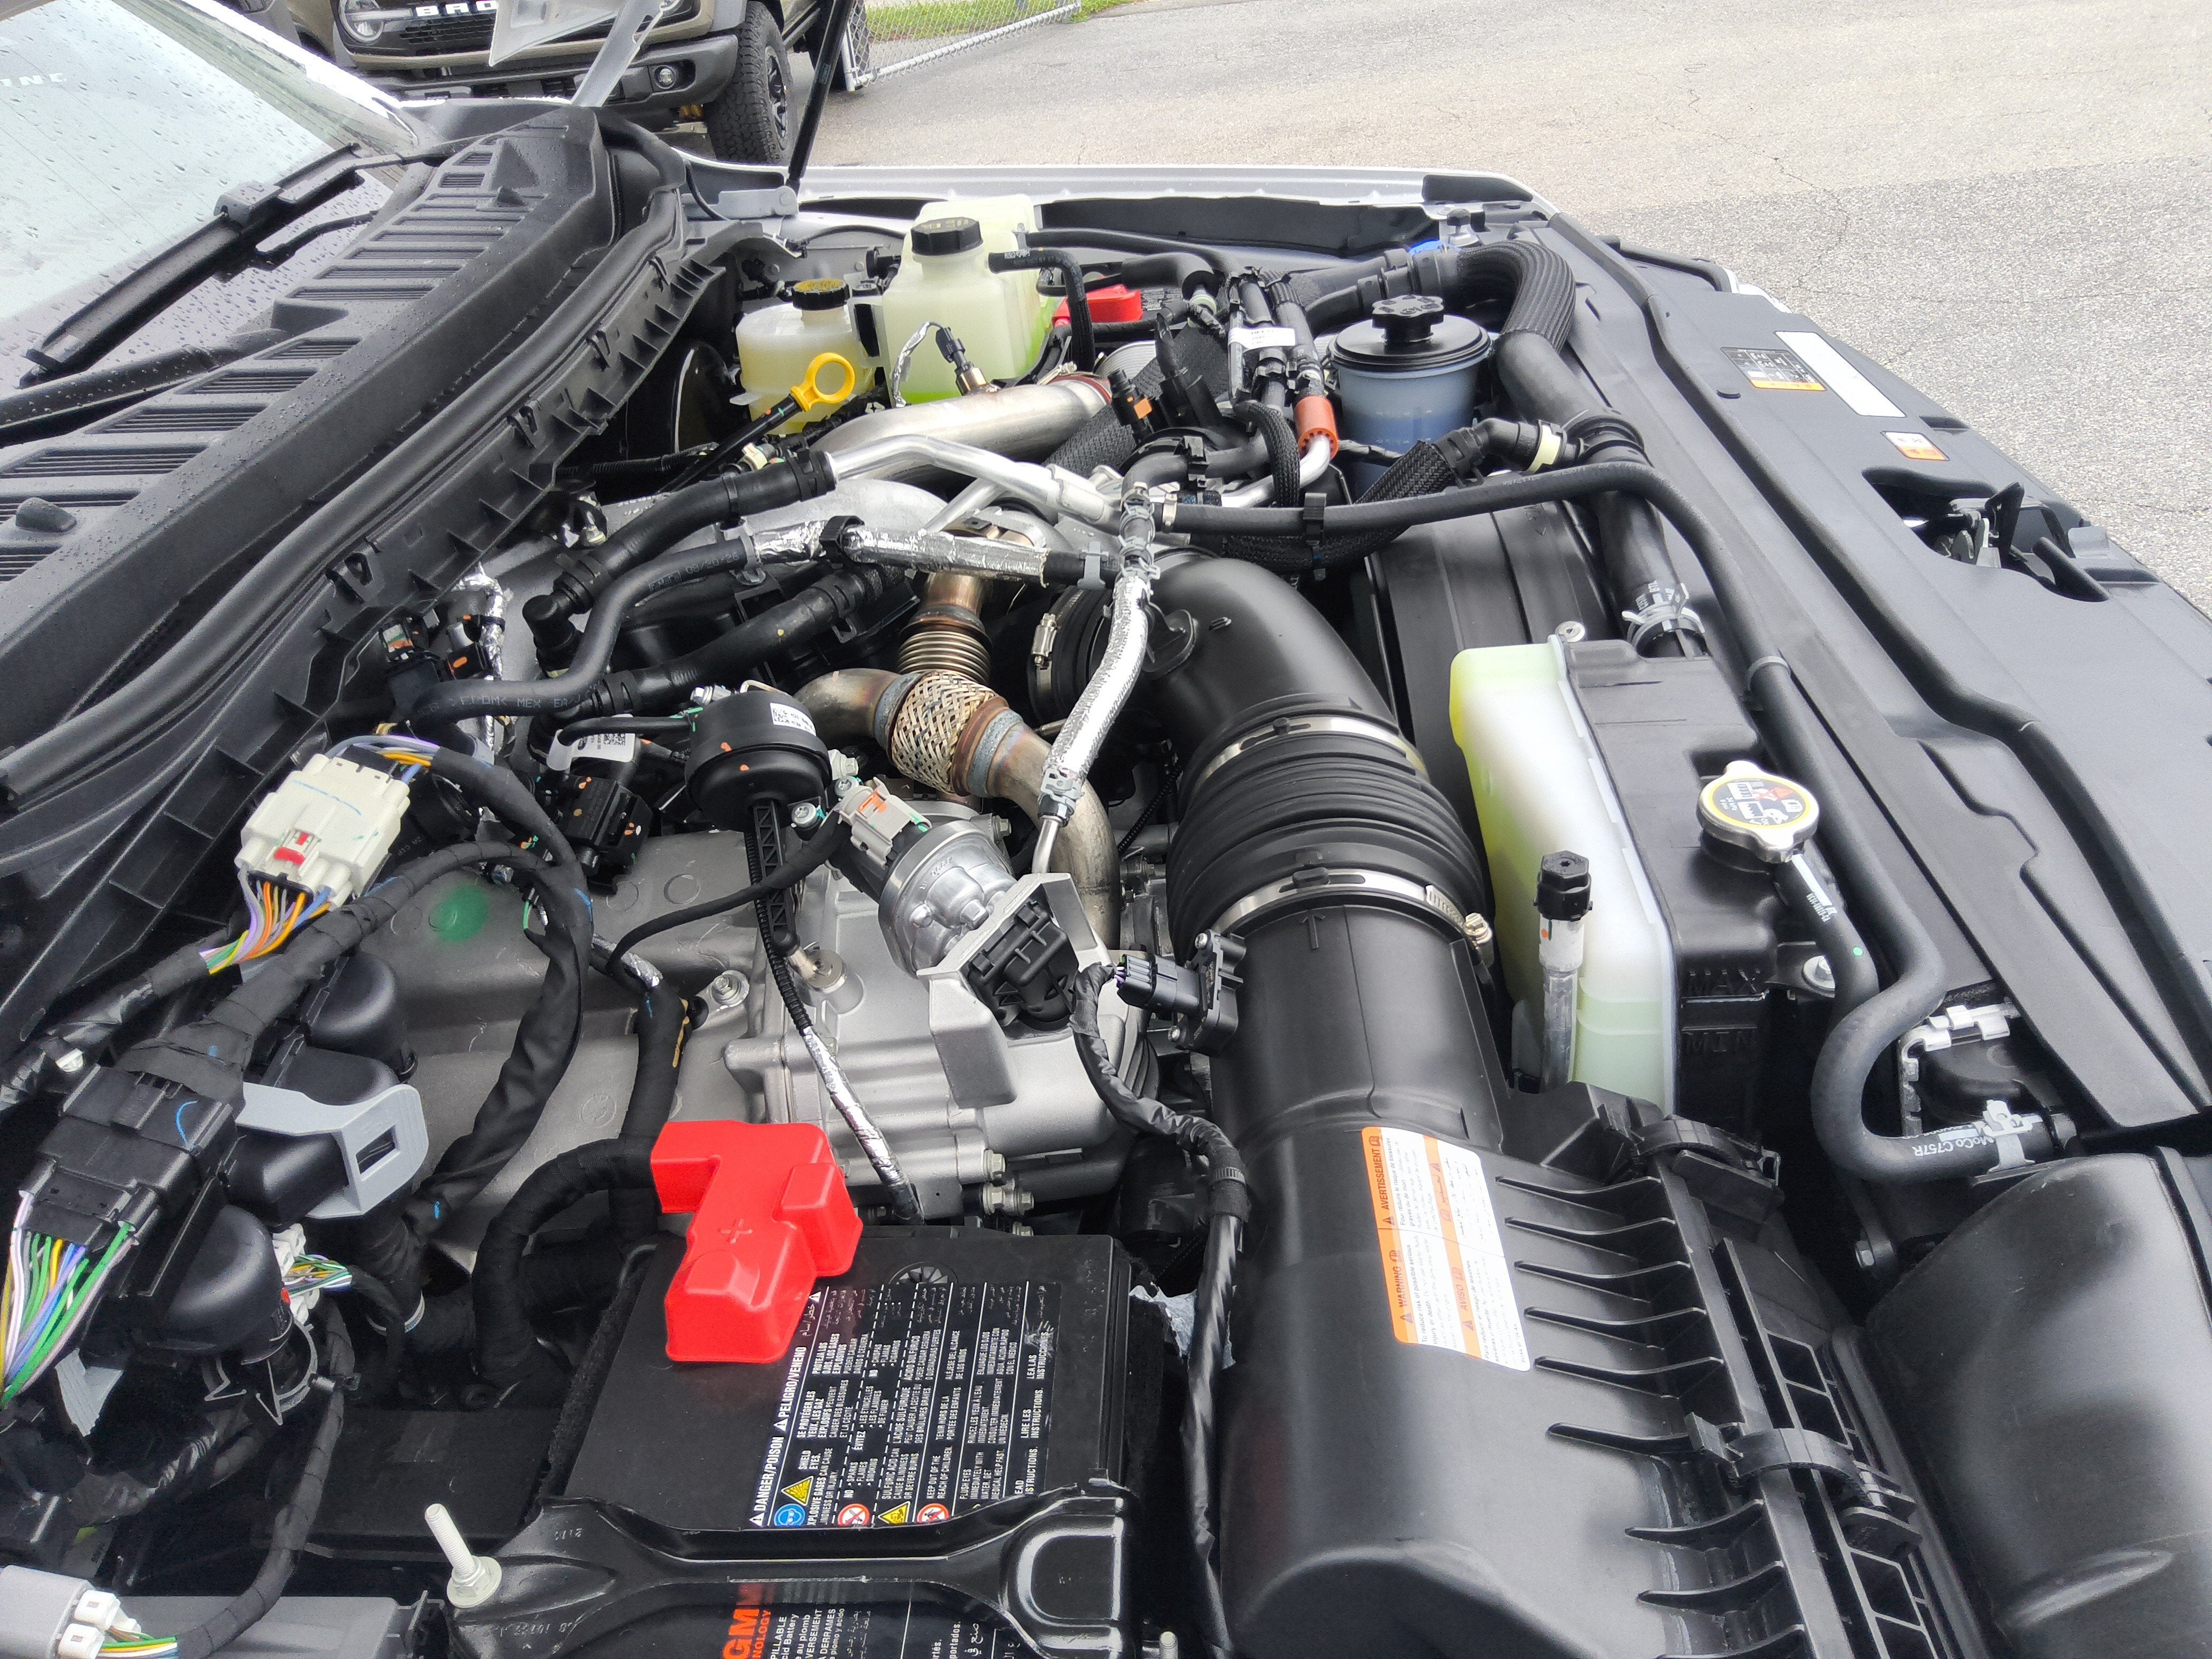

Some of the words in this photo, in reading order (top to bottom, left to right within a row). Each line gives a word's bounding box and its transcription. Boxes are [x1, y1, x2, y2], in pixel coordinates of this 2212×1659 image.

[1688, 968, 1761, 995] MAX
[1385, 1137, 1394, 1162] blessures
[1912, 1141, 1954, 1156] C757R
[1371, 1147, 1390, 1210] AVERTISSEMENT
[1406, 1208, 1415, 1227] graves
[1405, 1243, 1415, 1265] serious
[1409, 1266, 1419, 1291] possible
[1465, 1259, 1474, 1284] lesiones
[1392, 1264, 1408, 1309] WARNING
[1470, 1284, 1476, 1292] de
[1415, 1299, 1423, 1311] risk
[1455, 1283, 1468, 1311] AVISO
[1417, 1312, 1426, 1334] reduce
[817, 1342, 828, 1351] LOS
[827, 1333, 840, 1348] GASES
[847, 1337, 858, 1355] CAUSAR
[949, 1330, 960, 1350] ALCANCE
[980, 1343, 989, 1351] LOS
[1421, 1334, 1428, 1343] To
[825, 1349, 836, 1358] LOS
[871, 1343, 883, 1363] CHISPAS
[888, 1339, 901, 1363] CIGARROS
[917, 1349, 928, 1365] CAUSAR
[948, 1350, 957, 1359] DEL
[1482, 1344, 1490, 1359] Para
[1490, 1337, 1500, 1362] severas
[811, 1351, 826, 1374] PROTEJA
[821, 1359, 834, 1374] OJOS.
[831, 1343, 847, 1374] EXPLOSIVOS
[842, 1356, 854, 1374] PUEDEN
[1027, 1354, 1037, 1366] LAS
[868, 1369, 879, 1377] NO
[914, 1366, 925, 1380] PUEDE
[956, 1363, 965, 1372] LOS
[1026, 1366, 1036, 1379] LEA
[777, 1346, 807, 1417] PELIGRO/VENENO
[835, 1379, 849, 1407] BLESSURES
[869, 1389, 882, 1414] FLAMMES
[795, 1401, 814, 1430] PROTÉGER
[805, 1391, 816, 1400] LES
[813, 1398, 825, 1409] GAZ
[817, 1408, 833, 1438] EXPLOSIFS
[825, 1386, 838, 1407] PEUVENT
[833, 1407, 843, 1417] DES
[878, 1399, 890, 1416] FUMER
[895, 1386, 911, 1422] SULFURIQUE
[810, 1409, 821, 1420] LES
[858, 1415, 868, 1423] LES
[868, 1414, 877, 1423] LES
[937, 1410, 948, 1424] HORS
[949, 1409, 958, 1419] DES
[969, 1416, 978, 1425] LES
[1022, 1408, 1032, 1422] LES
[1030, 1387, 1044, 1438] INSTRUCTIONS.
[806, 1421, 819, 1438] YEUX.
[828, 1418, 841, 1438] CAUSER
[906, 1413, 917, 1431] CAUSER
[987, 1417, 999, 1444] CONSULTER
[1020, 1423, 1030, 1438] LIRE
[851, 1430, 866, 1450] ÉVITEZ
[892, 1422, 905, 1443] L'ACIDE
[914, 1433, 923, 1443] DES
[935, 1425, 945, 1440] TENIR
[797, 1449, 811, 1469] SHIELD
[808, 1453, 821, 1469] EYES.
[821, 1448, 833, 1464] CAUSE
[886, 1458, 899, 1470] ACID
[931, 1455, 941, 1465] THE
[940, 1445, 953, 1472] CHILDREN.
[974, 1451, 984, 1464] WITH
[753, 1436, 785, 1511] DANGER/POISON
[818, 1464, 829, 1476] CAN
[846, 1461, 858, 1482] SPARKS
[856, 1461, 868, 1482] FLAMES
[865, 1458, 878, 1482] SMOKING
[896, 1453, 909, 1481] BLINDNESS
[961, 1468, 972, 1482] EYES
[983, 1468, 992, 1479] GET
[993, 1463, 1004, 1476] HELP
[813, 1477, 826, 1496] GASES
[881, 1471, 896, 1499] SULFURIC
[904, 1470, 916, 1490] SEVERE
[928, 1473, 938, 1484] OUT
[969, 1465, 982, 1499] IMMEDIATELY
[1014, 1479, 1024, 1494] EAD
[843, 1489, 854, 1498] NO
[893, 1482, 905, 1499] CAUSE
[903, 1491, 913, 1499] OR
[925, 1485, 936, 1499] KEEP
[937, 1481, 948, 1499] REACH
[959, 1482, 969, 1499] FLUSH
[990, 1476, 1002, 1499] MEDICAL
[782, 1613, 799, 1645] Battery
[797, 1615, 811, 1641] plomb
[819, 1609, 836, 1654] DERRAMES
[797, 1643, 806, 1654] au
[831, 1634, 841, 1655] plomo
